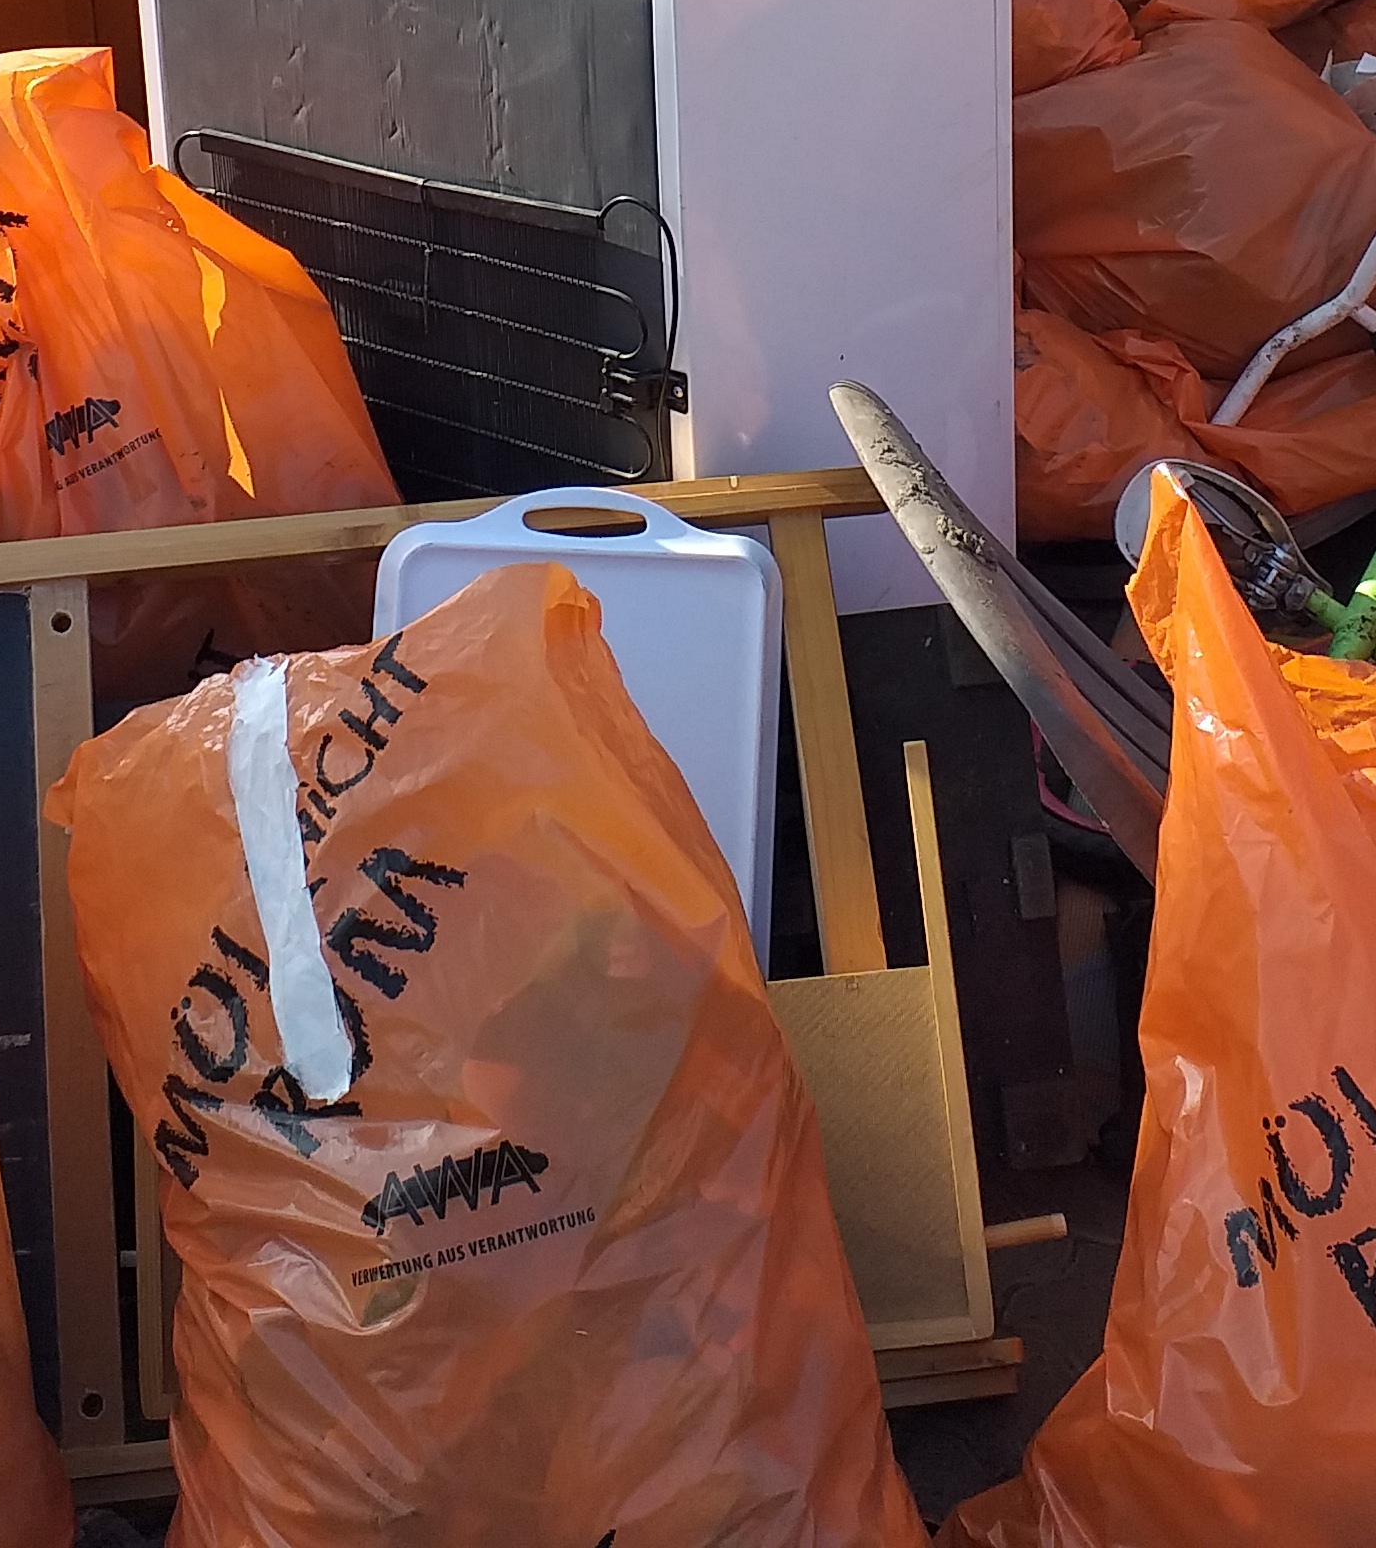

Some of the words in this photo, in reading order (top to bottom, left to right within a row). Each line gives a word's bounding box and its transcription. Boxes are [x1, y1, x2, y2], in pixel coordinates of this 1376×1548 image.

[366, 1139, 546, 1237] AWA
[351, 1254, 434, 1287] VERWERTUNG
[437, 1244, 467, 1267] AUS
[467, 1207, 597, 1258] VERANTWORTUNG
